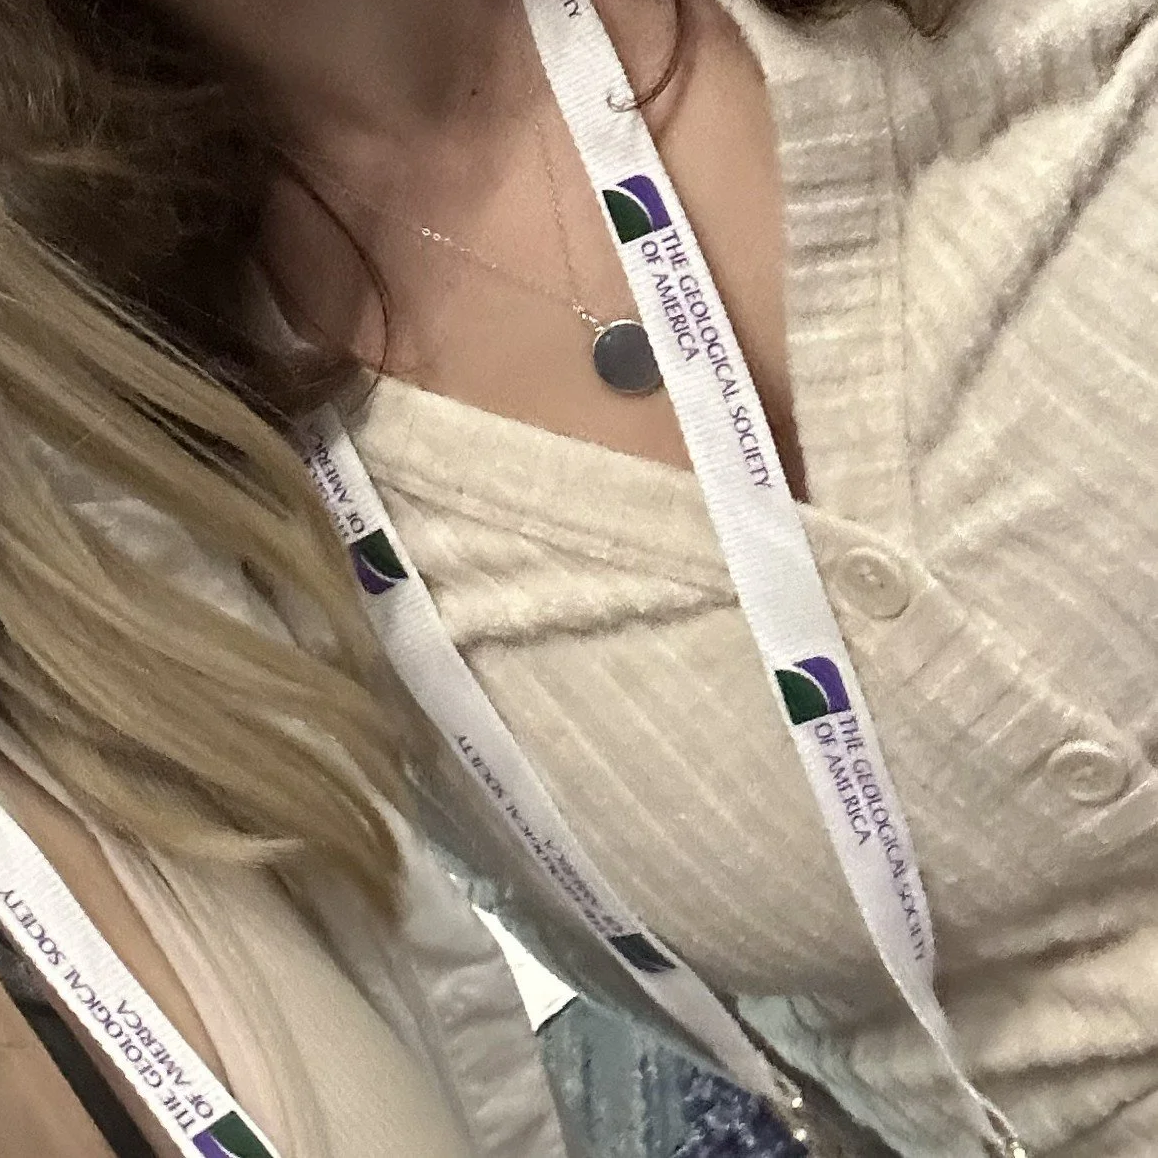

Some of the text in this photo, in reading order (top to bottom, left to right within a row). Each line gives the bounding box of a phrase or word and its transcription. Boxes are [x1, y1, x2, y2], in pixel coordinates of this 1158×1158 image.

[640, 240, 699, 362] OF AMERICA
[661, 229, 773, 489] THE GEOLOGICAL SOCIETY
[814, 722, 872, 846] OF AMERICA
[838, 714, 864, 752] THE
[852, 757, 906, 880] GEOLOGICAL
[64, 967, 164, 1090] GEOLOGICAL
[115, 999, 214, 1119] OF AMERICA
[162, 1089, 197, 1132] THE
